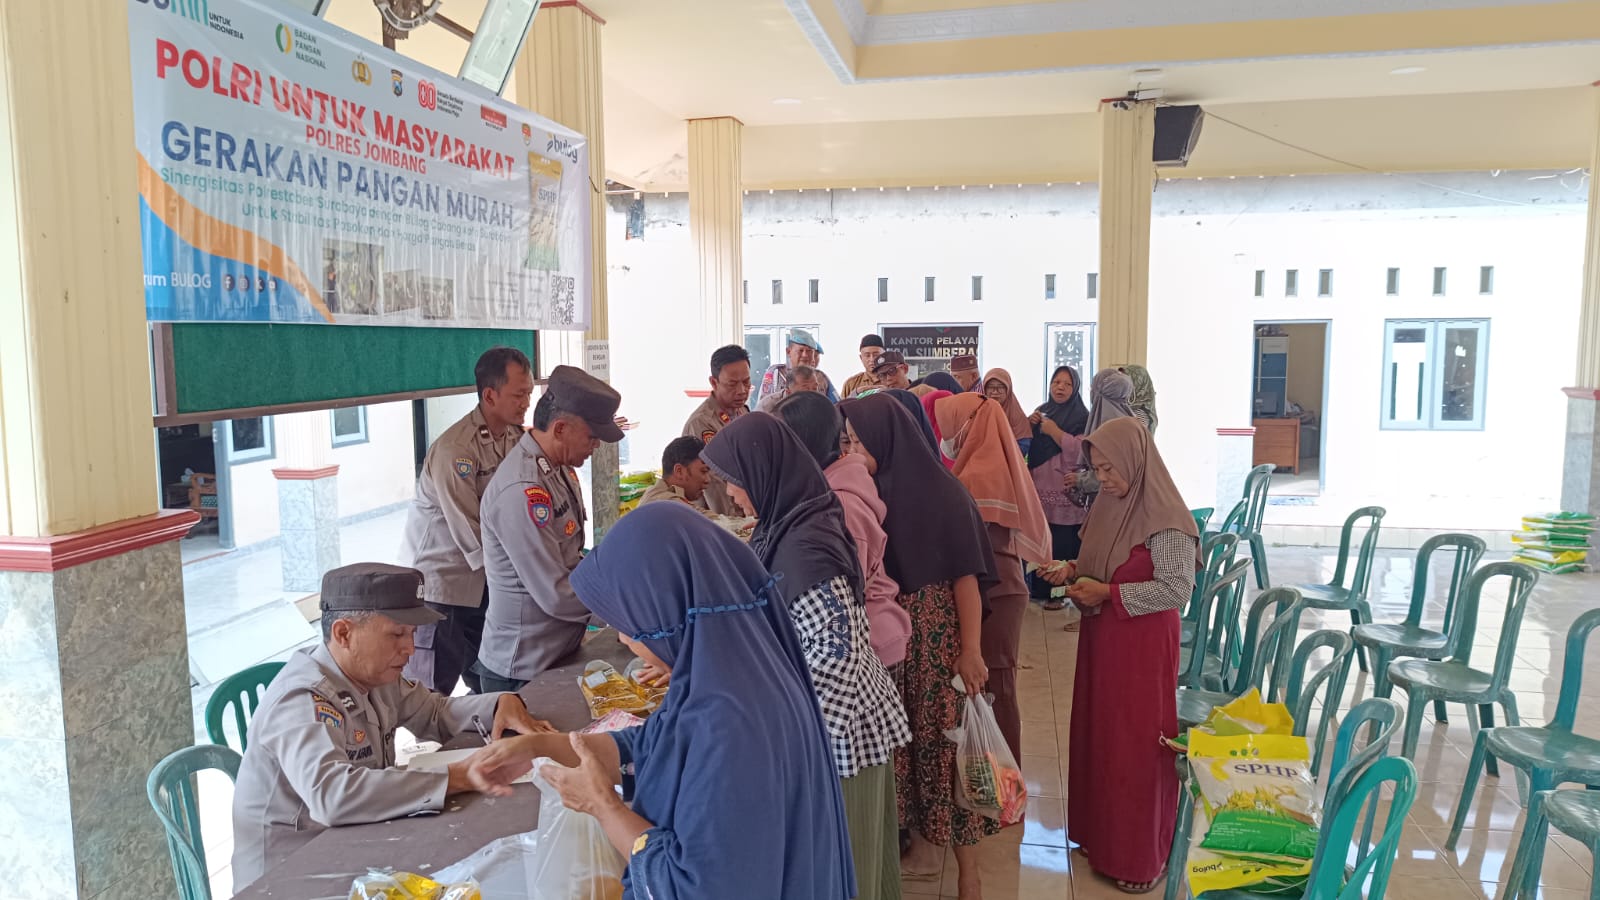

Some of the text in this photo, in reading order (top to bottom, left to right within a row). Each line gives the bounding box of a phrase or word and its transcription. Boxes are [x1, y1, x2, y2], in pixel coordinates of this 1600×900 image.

[209, 12, 231, 26] UNTUK
[209, 21, 244, 40] INDONESIA
[294, 28, 316, 44] BADAN
[295, 40, 322, 57] PANGAN
[295, 51, 326, 69] NASIONAL
[156, 38, 515, 180] POLRI UNTUK MASYARAKAT
[306, 124, 427, 175] POLRES JOMBANG
[161, 120, 513, 230] GERAKAN PANGAN MURAH
[161, 167, 244, 193] Sinergisitas
[171, 272, 212, 289] BULOG
[890, 336, 934, 346] KANTOR
[1234, 763, 1298, 778] SPHP
